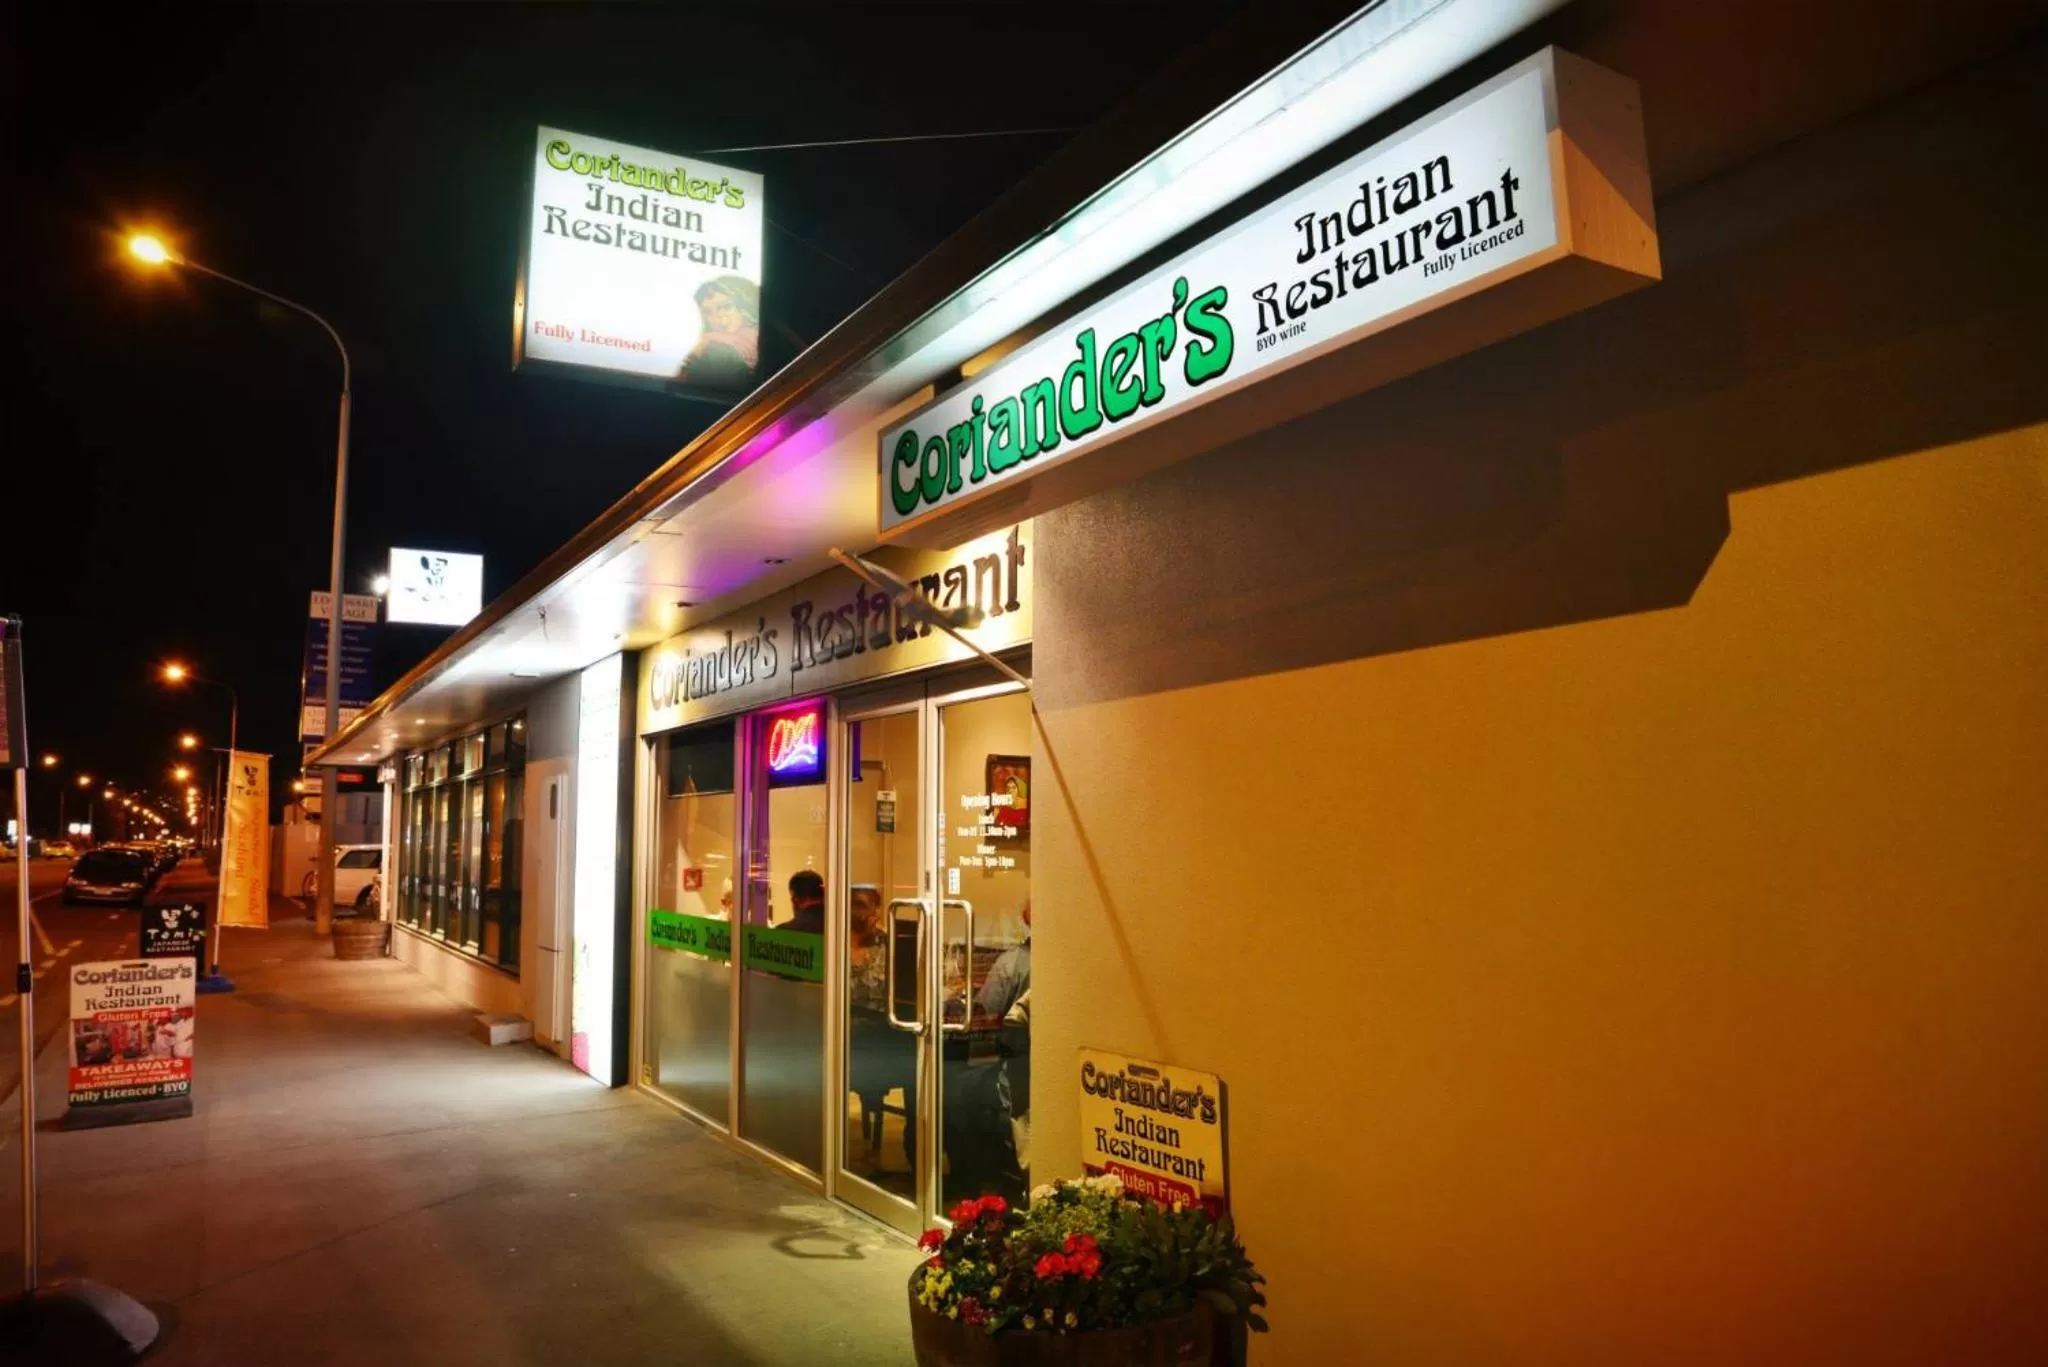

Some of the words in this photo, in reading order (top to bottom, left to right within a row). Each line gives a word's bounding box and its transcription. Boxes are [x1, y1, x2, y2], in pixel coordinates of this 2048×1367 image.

[545, 139, 745, 209] Coriander's
[585, 183, 703, 233] Indian
[1294, 154, 1454, 264] Indian
[543, 204, 742, 270] Restaurant
[1252, 167, 1519, 335] Restaurant
[1423, 251, 1457, 278] Fully
[1461, 219, 1525, 261] Licenced
[534, 320, 575, 342] Fully
[581, 328, 651, 353] Licensed
[1256, 333, 1277, 352] BYO
[1279, 319, 1307, 342] wine
[891, 276, 1234, 516] Coriander's
[650, 617, 778, 712] Coriander's
[769, 712, 817, 769] Open
[747, 931, 814, 970] Restaurant
[74, 964, 192, 985] Coriander's
[104, 985, 163, 998] Indian
[85, 994, 182, 1011] Restaurant
[98, 1012, 139, 1023] Gluten
[141, 1009, 170, 1020] Free
[79, 1059, 184, 1077] TAKEAWAYS
[70, 1091, 101, 1103] Fully
[104, 1085, 157, 1099] Licenced
[163, 1081, 188, 1093] BYO
[1081, 1061, 1217, 1125] Coriander's
[1113, 1107, 1180, 1149] Indian
[1094, 1127, 1205, 1182] Restaurant
[1158, 1180, 1191, 1207] Free
